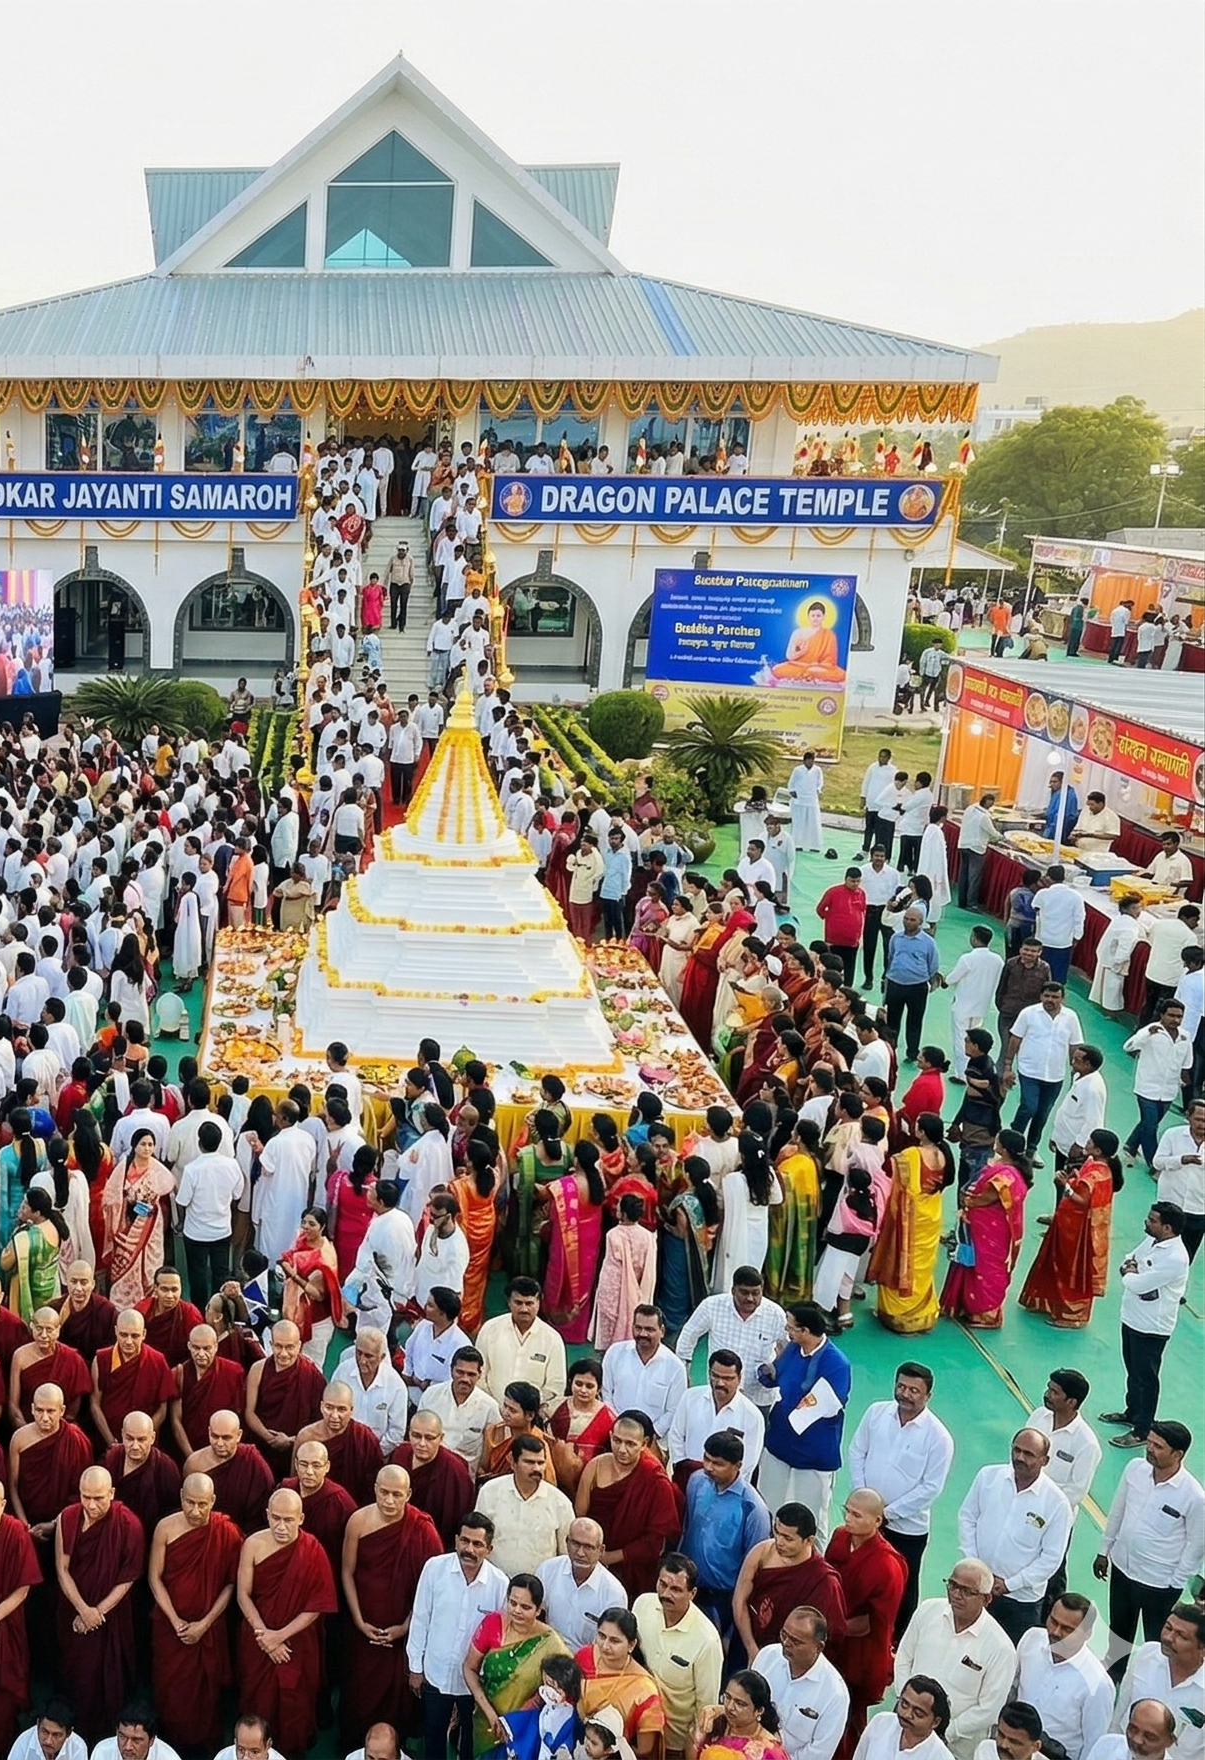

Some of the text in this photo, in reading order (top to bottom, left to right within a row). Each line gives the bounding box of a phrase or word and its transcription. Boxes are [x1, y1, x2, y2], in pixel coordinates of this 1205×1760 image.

[62, 482, 163, 510] JAYANTI
[169, 483, 293, 511] SAMAROH
[540, 485, 891, 517] DRAGON PALACE TEMPLE
